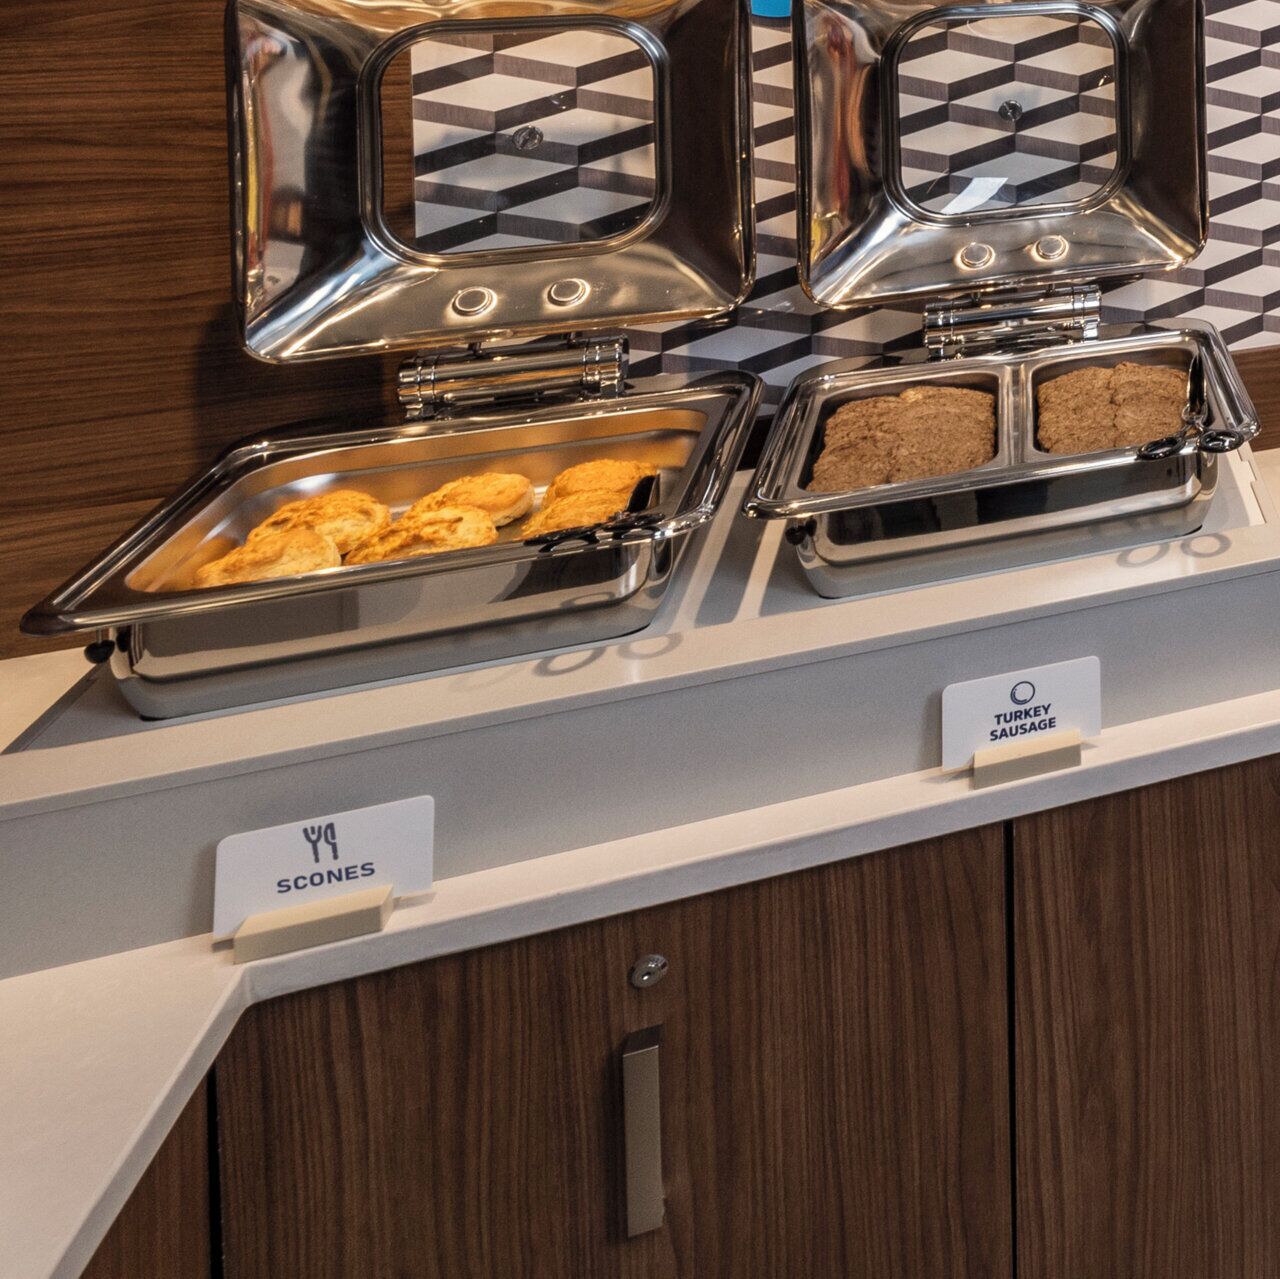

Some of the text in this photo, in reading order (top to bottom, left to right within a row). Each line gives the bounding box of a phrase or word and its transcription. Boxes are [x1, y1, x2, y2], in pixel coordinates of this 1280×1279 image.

[994, 703, 1052, 726] TURKEY
[989, 717, 1056, 741] SAUSAGE
[276, 862, 376, 894] SCONES
